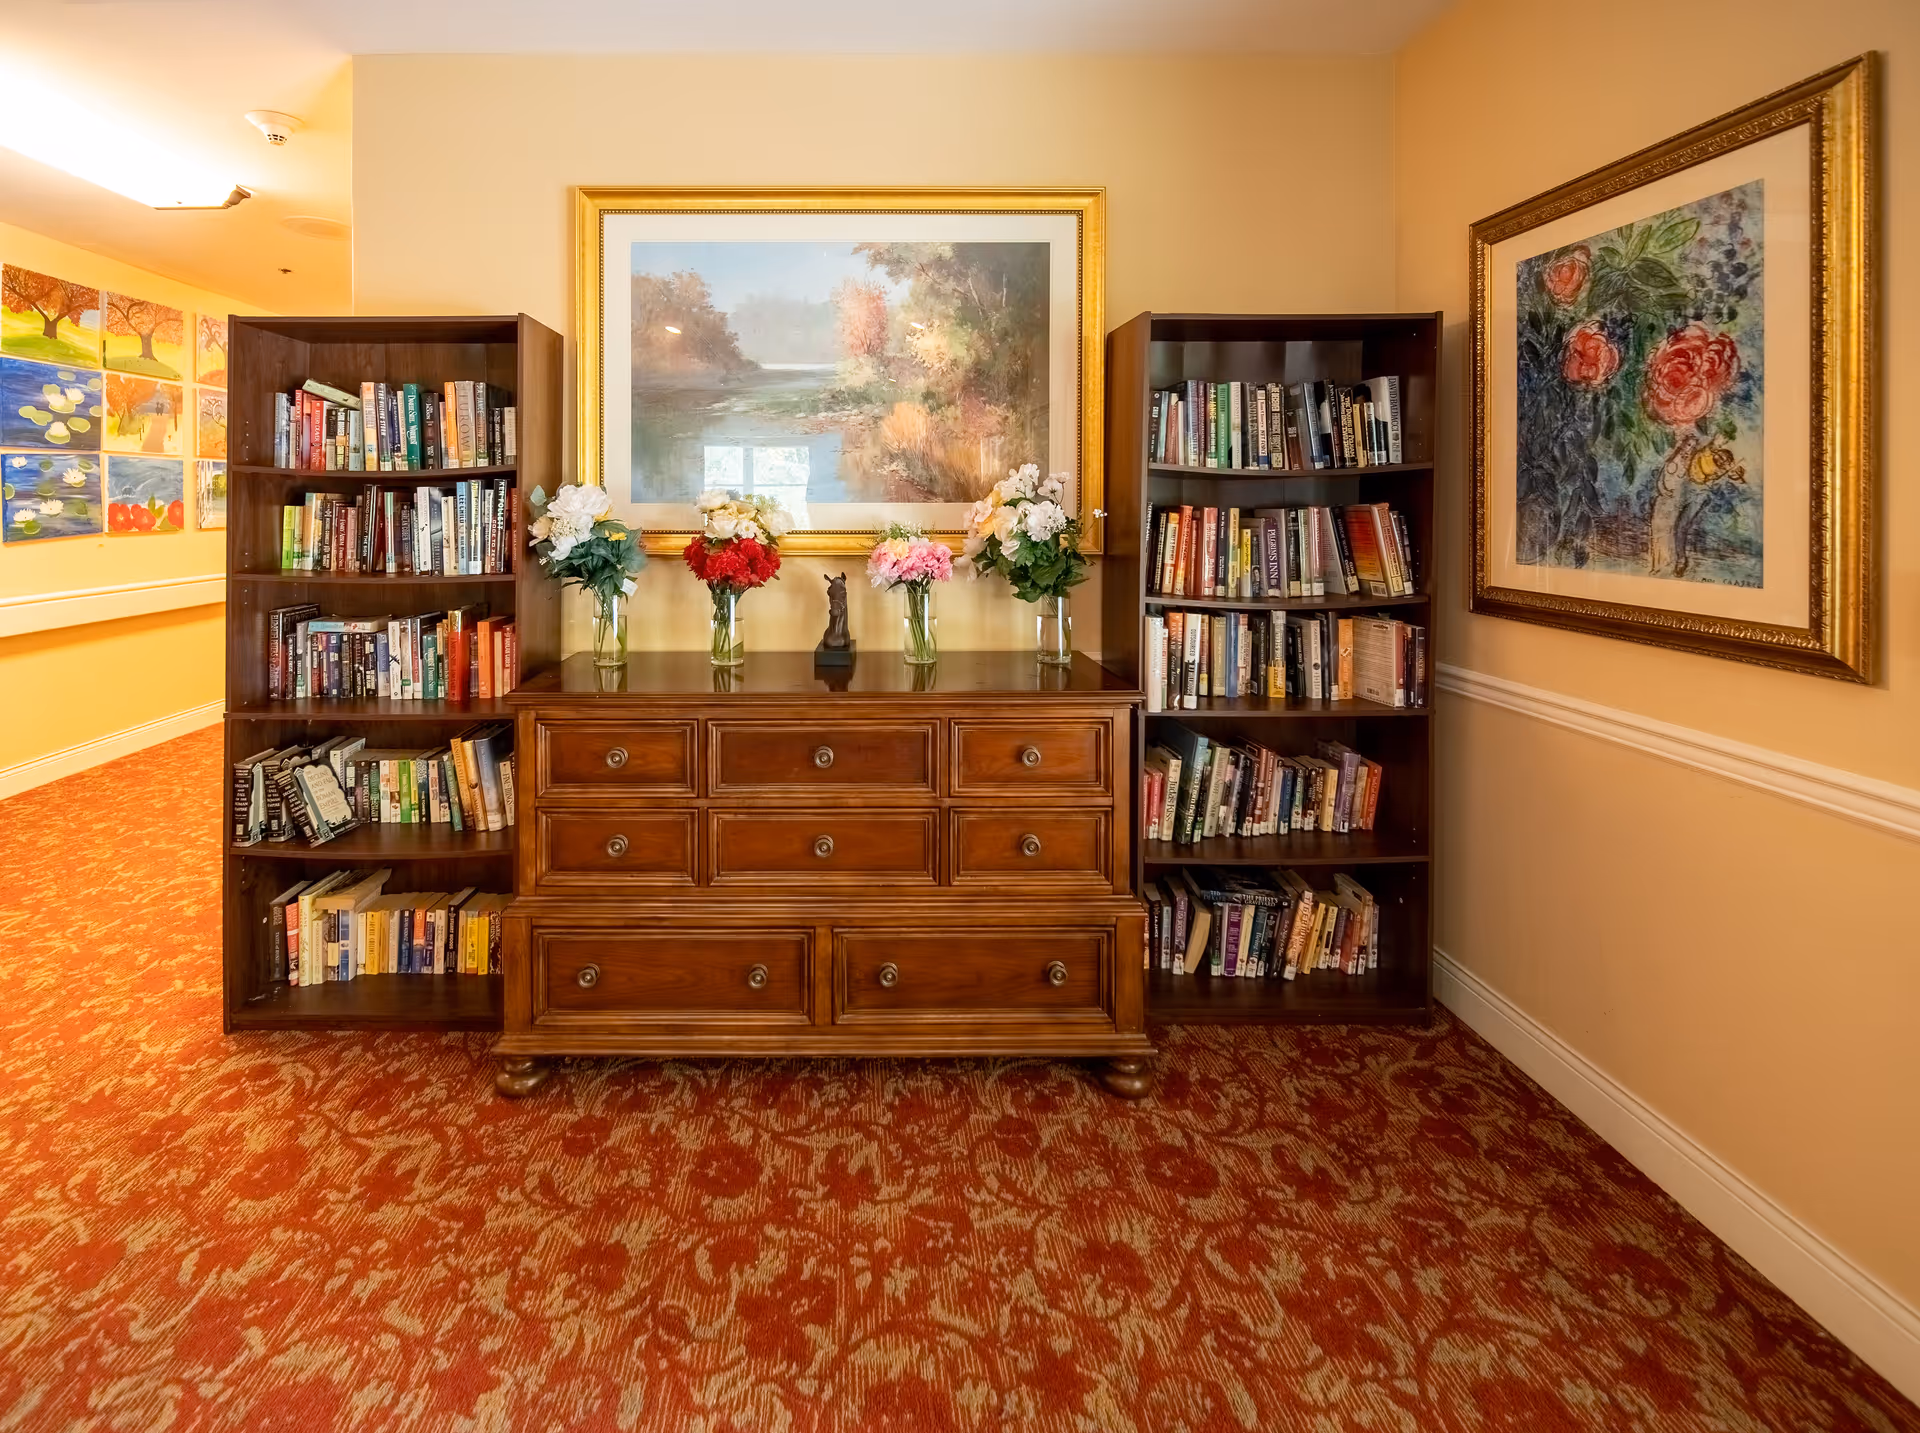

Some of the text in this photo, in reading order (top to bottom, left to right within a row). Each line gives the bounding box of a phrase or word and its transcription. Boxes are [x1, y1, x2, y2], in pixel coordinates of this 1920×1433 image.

[1388, 378, 1398, 398] DAVID
[378, 401, 386, 419] KILLING
[407, 394, 417, 411] DANIELLE
[1390, 398, 1400, 432] BALDACCI
[379, 420, 387, 437] STORM
[1347, 435, 1355, 458] PELHAM
[401, 509, 410, 526] HARLAN
[459, 505, 467, 524] CHILD
[401, 526, 411, 541] COBEN
[1336, 518, 1350, 557] SHOCK WAVE
[491, 539, 496, 548] TO
[1267, 529, 1279, 579] PILGRIM'S INN
[1189, 628, 1197, 656] OUTSOURCED
[452, 741, 465, 785] DANIELLE STEEL
[307, 770, 330, 783] DECLINE
[323, 775, 336, 785] FALL
[502, 773, 510, 786] FINE
[316, 790, 336, 801] ROMAN
[319, 797, 339, 810] EMPIRE
[1165, 776, 1178, 822] Judas Kiss
[1185, 756, 1204, 835] America From the Road
[1209, 800, 1218, 818] Star
[1255, 895, 1279, 904] PRIEST'S
